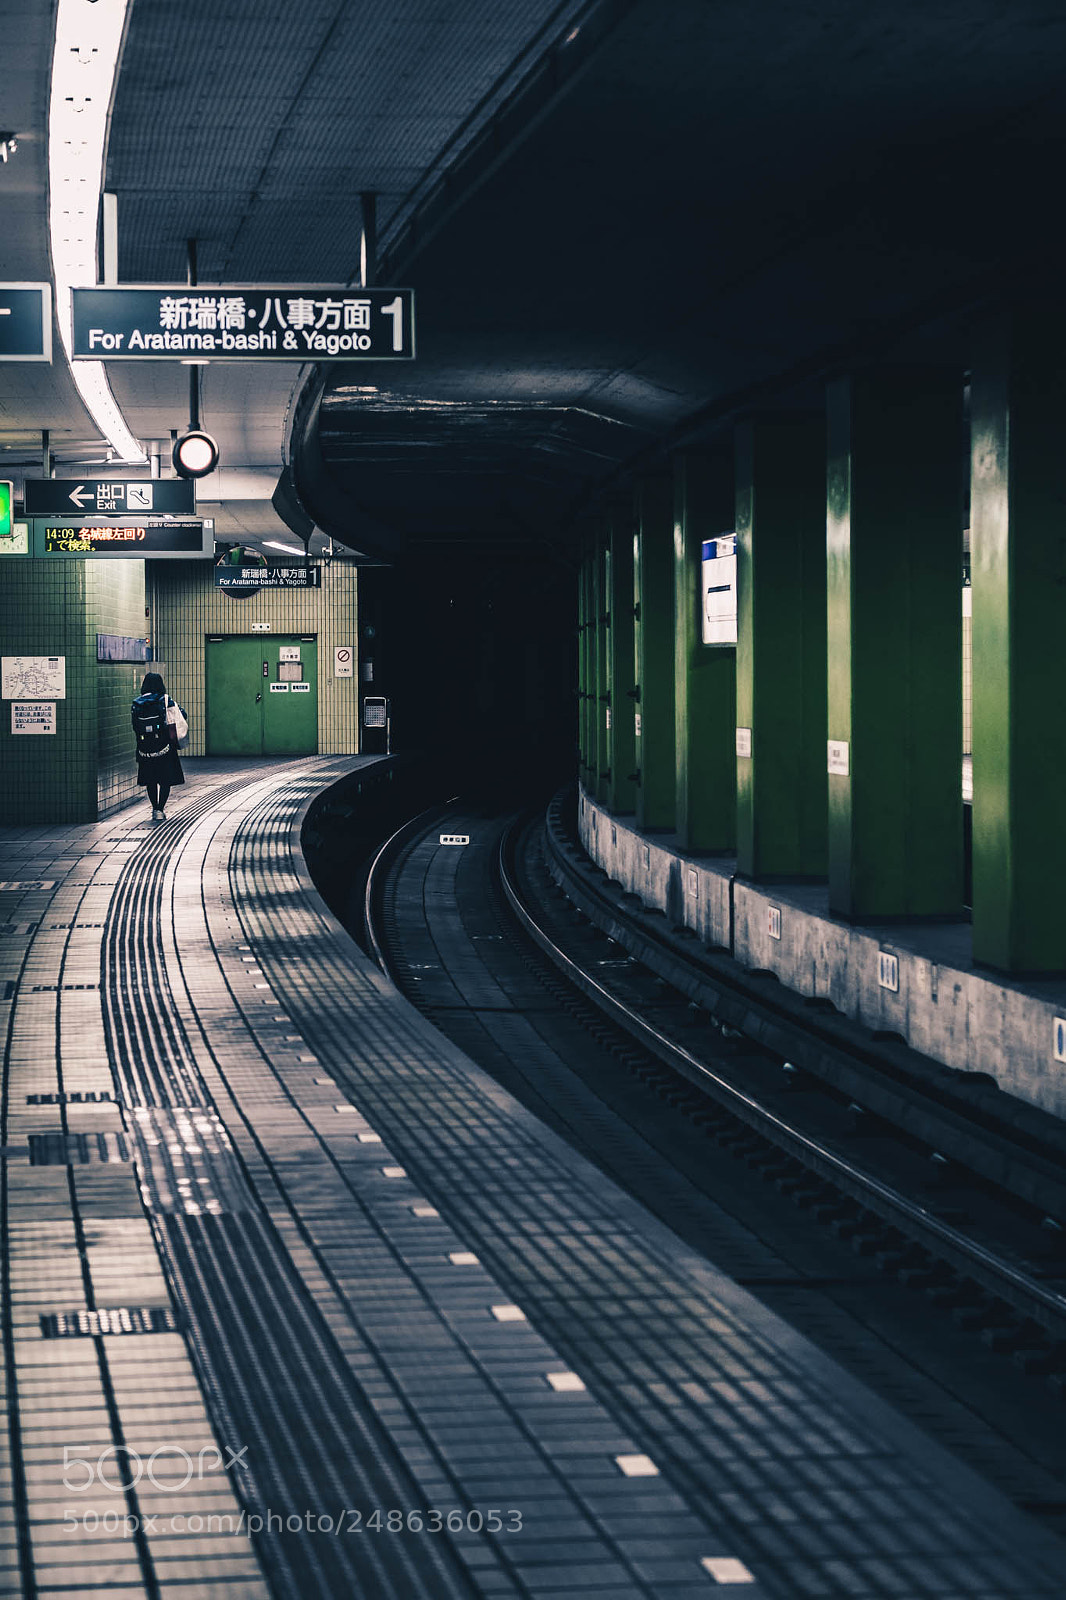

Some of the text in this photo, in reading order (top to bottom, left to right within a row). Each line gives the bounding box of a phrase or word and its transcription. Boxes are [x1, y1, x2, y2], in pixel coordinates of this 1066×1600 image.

[159, 296, 372, 330] 新瑞橋・八事方面
[381, 296, 403, 351] 1
[89, 329, 372, 355] For Aratama-bashi & Yagoto
[97, 484, 125, 500] 出口
[97, 500, 116, 510] Exit
[46, 527, 146, 541] 14:09 名城線左回り
[241, 568, 307, 579] 新瑞橋・八事方面
[309, 567, 317, 585] 1
[285, 578, 307, 586] Yagoto
